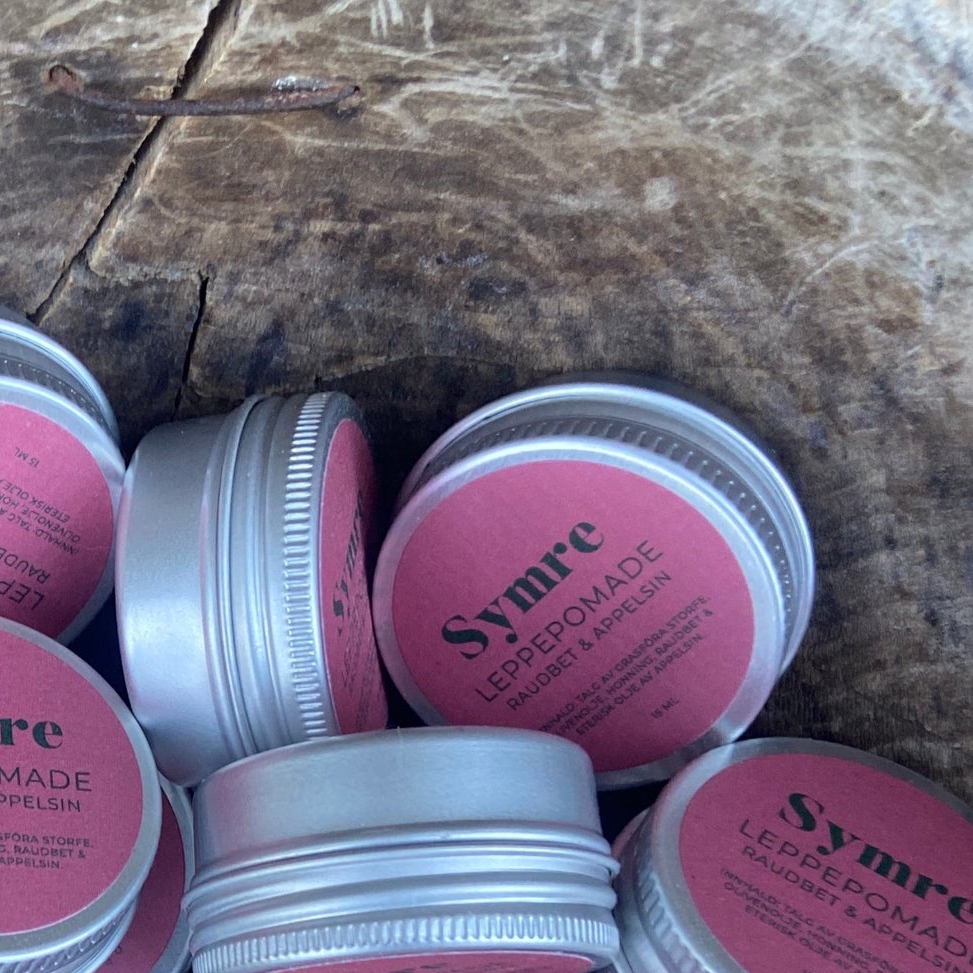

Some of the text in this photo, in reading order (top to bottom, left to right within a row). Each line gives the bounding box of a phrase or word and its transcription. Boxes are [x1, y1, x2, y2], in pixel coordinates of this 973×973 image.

[13, 446, 41, 468] 15 ML
[440, 522, 604, 660] Symre
[473, 538, 663, 703] LEPPEPOMADE
[505, 569, 672, 712] RAUDBET & APPELSIN
[13, 844, 73, 858] RAUDBET
[77, 849, 86, 859] &
[737, 818, 973, 967] LEPPEPOMAD
[740, 844, 842, 906] RAUDBET
[844, 905, 857, 919] &
